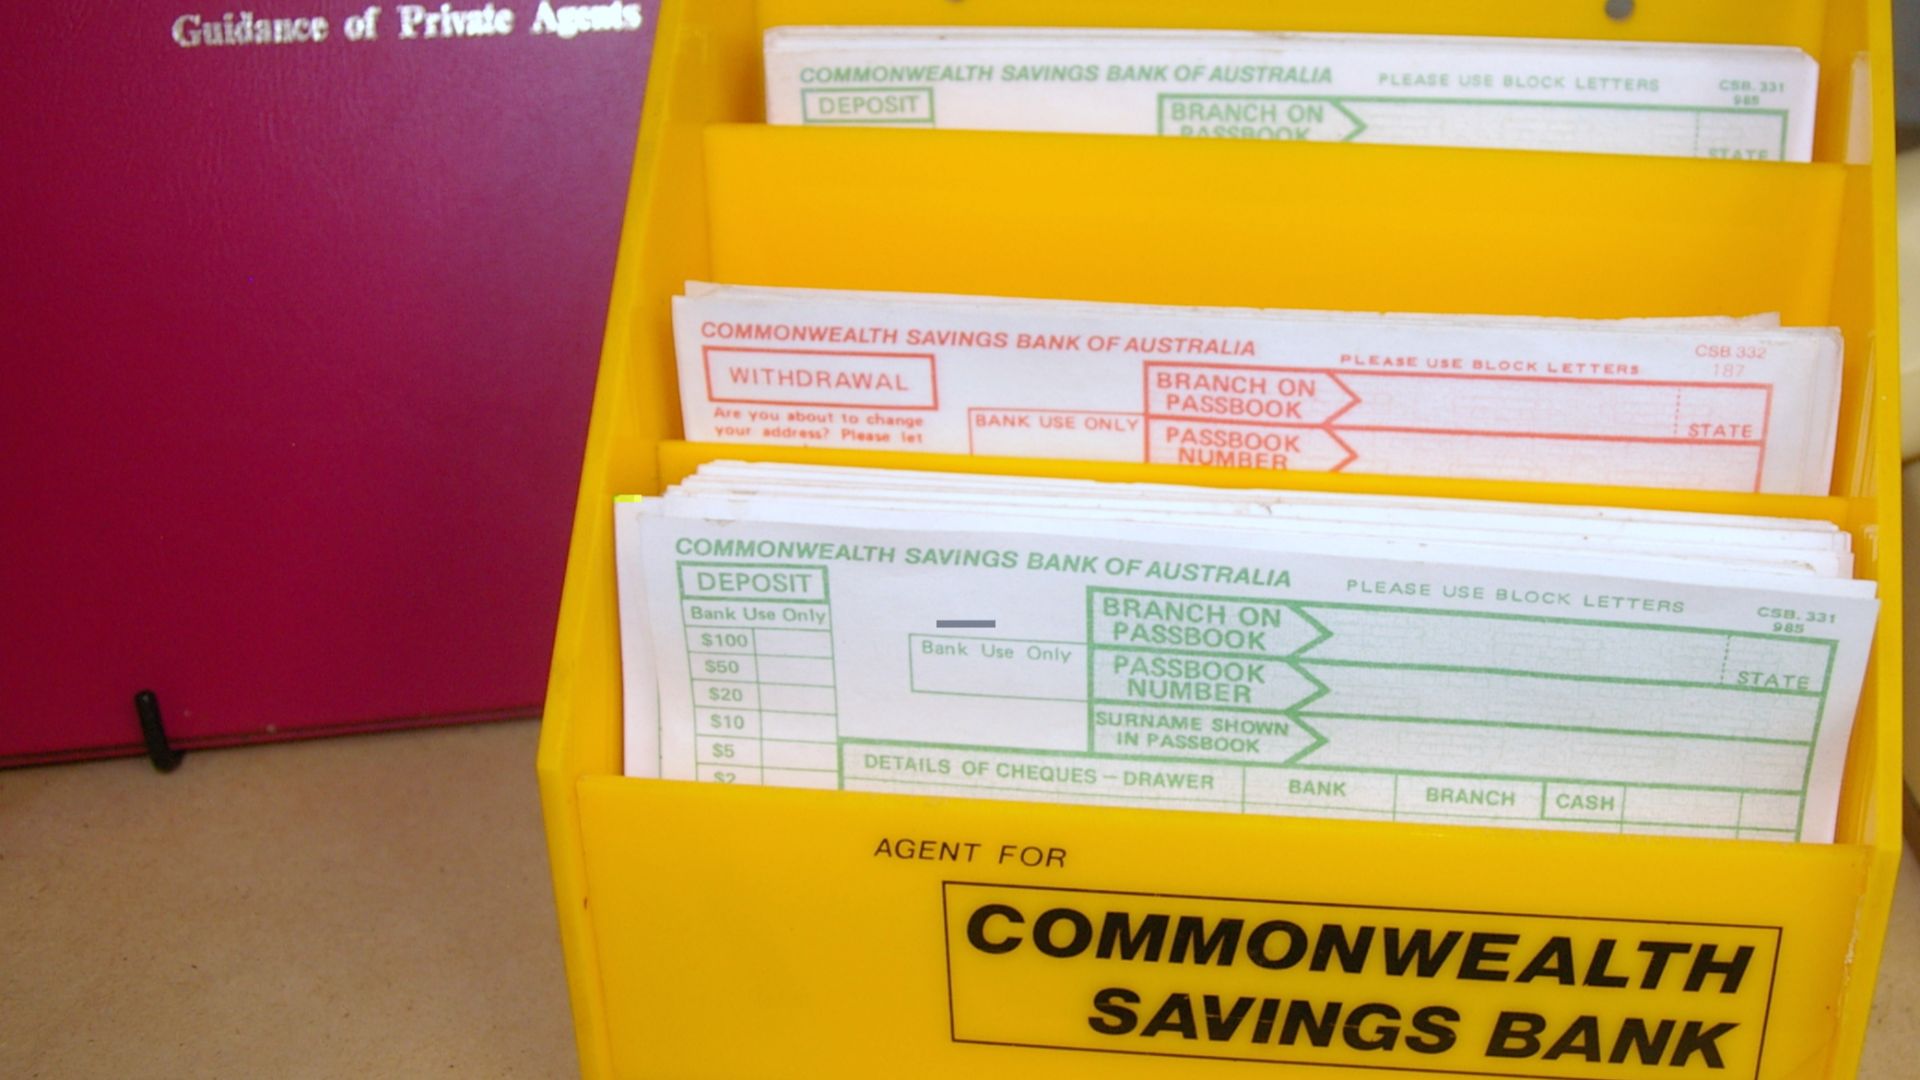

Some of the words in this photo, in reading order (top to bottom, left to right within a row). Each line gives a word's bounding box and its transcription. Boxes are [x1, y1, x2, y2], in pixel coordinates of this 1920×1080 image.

[172, 12, 330, 48] Guidance
[343, 5, 381, 40] of
[398, 3, 516, 38] Private
[530, 0, 642, 38] Agents
[800, 64, 994, 84] COMMONWEALTH
[1000, 65, 1100, 82] SAVINGS
[1106, 65, 1168, 83] BANK
[1173, 66, 1205, 83] OF
[1209, 66, 1333, 84] AUSTRALIA
[1378, 73, 1450, 86] PLEASE
[1459, 74, 1495, 87] USE
[1503, 75, 1566, 89] BLOCK
[1575, 77, 1660, 92] LETTERS
[1760, 81, 1785, 92] 331
[818, 94, 920, 115] DEPOSIT
[1170, 102, 1277, 123] BRANCH
[1286, 104, 1324, 123] ON
[1180, 124, 1311, 140] PASSBOOK
[1708, 148, 1769, 160] STATE
[701, 322, 898, 345] COMMONWEALTH
[905, 329, 1008, 348] SAVINGS
[1016, 334, 1080, 350] BANK
[1086, 336, 1121, 352] OF
[1124, 337, 1256, 357] AUSTRALIA
[1695, 344, 1731, 358] CSB
[1735, 346, 1768, 359] 332
[1340, 354, 1418, 368] PLEASE
[1426, 358, 1463, 370] USE
[1473, 361, 1538, 373] BLOCK
[1547, 363, 1640, 376] LETTERS
[1713, 363, 1746, 377] 187
[728, 366, 910, 392] WITHDRAWAL
[1156, 372, 1267, 395] BRANCH
[1278, 378, 1316, 398] ON
[1166, 394, 1302, 419] PASSBOOK
[714, 408, 741, 418] Are
[749, 410, 779, 421] you
[787, 411, 833, 424] about
[842, 414, 859, 424] to
[866, 414, 923, 427] change
[975, 413, 1030, 429] BANK
[1039, 415, 1077, 430] USE
[1084, 417, 1139, 432] ONLY
[715, 424, 751, 436] your
[762, 427, 830, 440] address?
[841, 429, 890, 442] Please
[902, 432, 923, 443] let
[1166, 427, 1301, 453] PASSBOOK
[1688, 424, 1753, 438] STATE
[1178, 447, 1288, 470] NUMBER
[675, 538, 896, 563] COMMONWEALTH
[905, 547, 1018, 569] SAVINGS
[1026, 552, 1098, 574] BANK
[1105, 557, 1141, 576] OF
[1146, 561, 1292, 588] AUSTRALIA
[698, 572, 812, 594] DEPOSIT
[1347, 579, 1432, 597] PLEASE
[1443, 585, 1485, 601] USE
[1496, 588, 1571, 606] BLOCK
[1583, 594, 1685, 615] LETTERS
[690, 606, 736, 621] Bank
[743, 607, 776, 621] Use
[782, 608, 826, 625] Only
[1103, 596, 1227, 626] BRANCH
[1238, 606, 1281, 628] ON
[1757, 606, 1800, 621] CSB.
[1806, 612, 1837, 625] 331
[1113, 621, 1267, 652] PASSBOOK
[1773, 622, 1805, 634] 985
[701, 633, 748, 648] $100
[921, 640, 968, 657] Bank
[981, 643, 1014, 659] Use
[1026, 646, 1072, 663] Only
[704, 660, 740, 674] $50
[1113, 655, 1266, 685] PASSBOOK
[1738, 671, 1811, 691] STATE
[708, 687, 743, 702] $20
[1127, 679, 1252, 704] NUMBER
[710, 714, 745, 730] $10
[1096, 712, 1204, 733] SURNAME
[1211, 717, 1290, 737] SHOWN
[712, 743, 736, 759] $5
[1116, 732, 1139, 747] IN
[1146, 733, 1261, 754] PASSBOOK
[714, 771, 737, 784] $2
[864, 754, 951, 775] DETAILS
[961, 760, 989, 777] OF
[995, 763, 1098, 784] CHEQUES
[1123, 771, 1215, 790] DRAWER
[1288, 779, 1347, 797] BANK
[1426, 787, 1517, 806] BRANCH
[1555, 793, 1615, 811] CASH
[873, 838, 981, 863] AGENT
[998, 846, 1069, 868] FOR
[964, 902, 1756, 994] COMMONWEALTH
[1087, 986, 1459, 1054] SAVINGS
[1484, 1010, 1740, 1070] BANK
